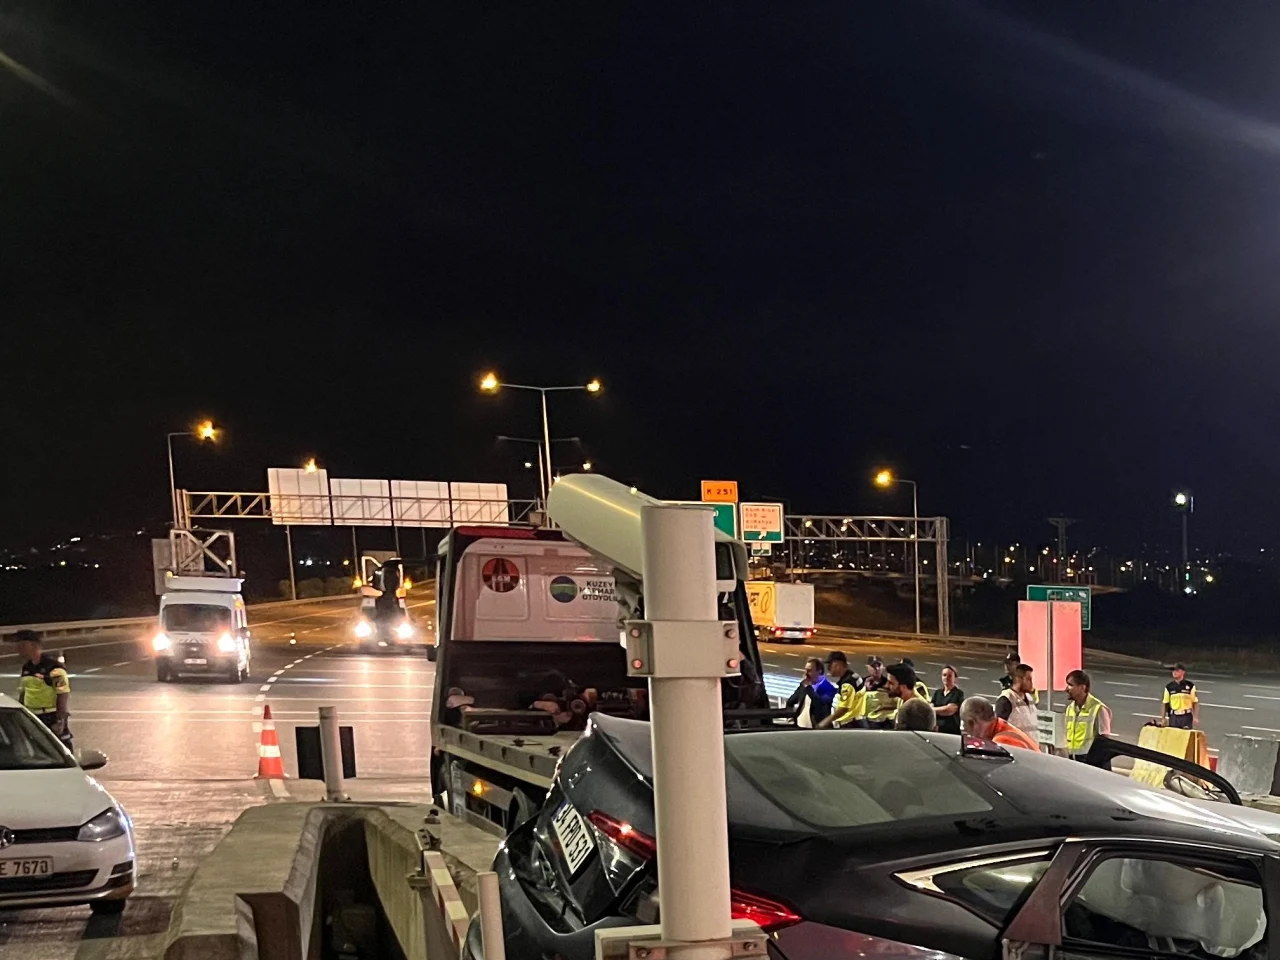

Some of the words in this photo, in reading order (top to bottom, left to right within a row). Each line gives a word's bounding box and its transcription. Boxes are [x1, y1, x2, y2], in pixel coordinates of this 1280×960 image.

[586, 580, 613, 588] KUZEY
[579, 587, 615, 595] MARMAR
[555, 804, 574, 829] 34
[569, 833, 591, 869] 531
[13, 860, 49, 876] 7670
